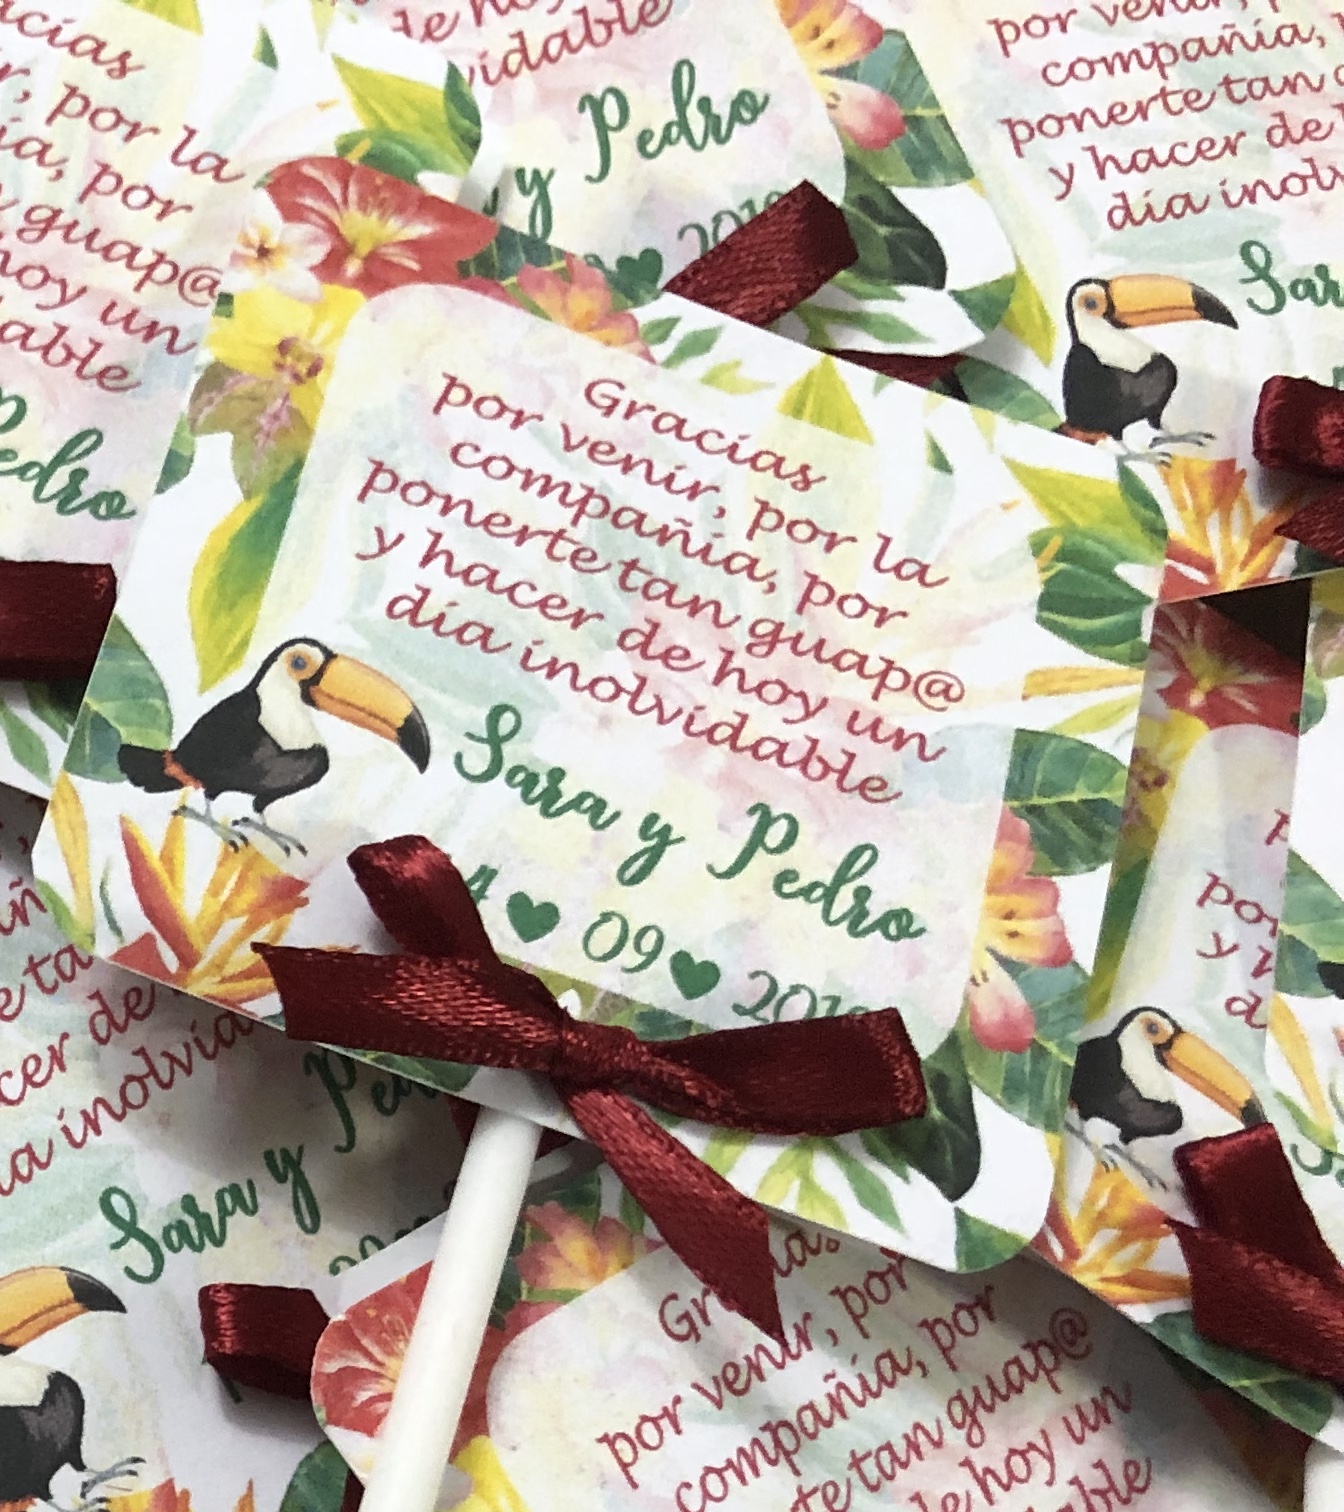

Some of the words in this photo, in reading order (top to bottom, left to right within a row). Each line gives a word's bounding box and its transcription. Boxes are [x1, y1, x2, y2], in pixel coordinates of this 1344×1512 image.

[577, 58, 770, 183] Pedro
[1001, 86, 1216, 158] ponerte
[1219, 72, 1324, 105] tan
[1083, 131, 1246, 180] hacer
[78, 160, 193, 221] por
[17, 203, 223, 304] guap@
[433, 373, 544, 430] por
[561, 423, 726, 519] venir,
[746, 496, 858, 554] por
[873, 533, 949, 588] la
[584, 379, 827, 492] Gracias
[357, 458, 611, 573] ponerte
[619, 558, 741, 629] tan
[745, 618, 965, 712] guap@
[795, 570, 909, 628] por
[520, 640, 901, 804] inolvidable
[455, 702, 618, 829] Sara
[618, 812, 686, 887] y
[708, 804, 926, 939] Pedro
[99, 1178, 261, 1285] Sara
[263, 1143, 317, 1233] y
[920, 1282, 1000, 1374] por
[848, 1420, 944, 1493] tan
[947, 1311, 1092, 1448] guap@
